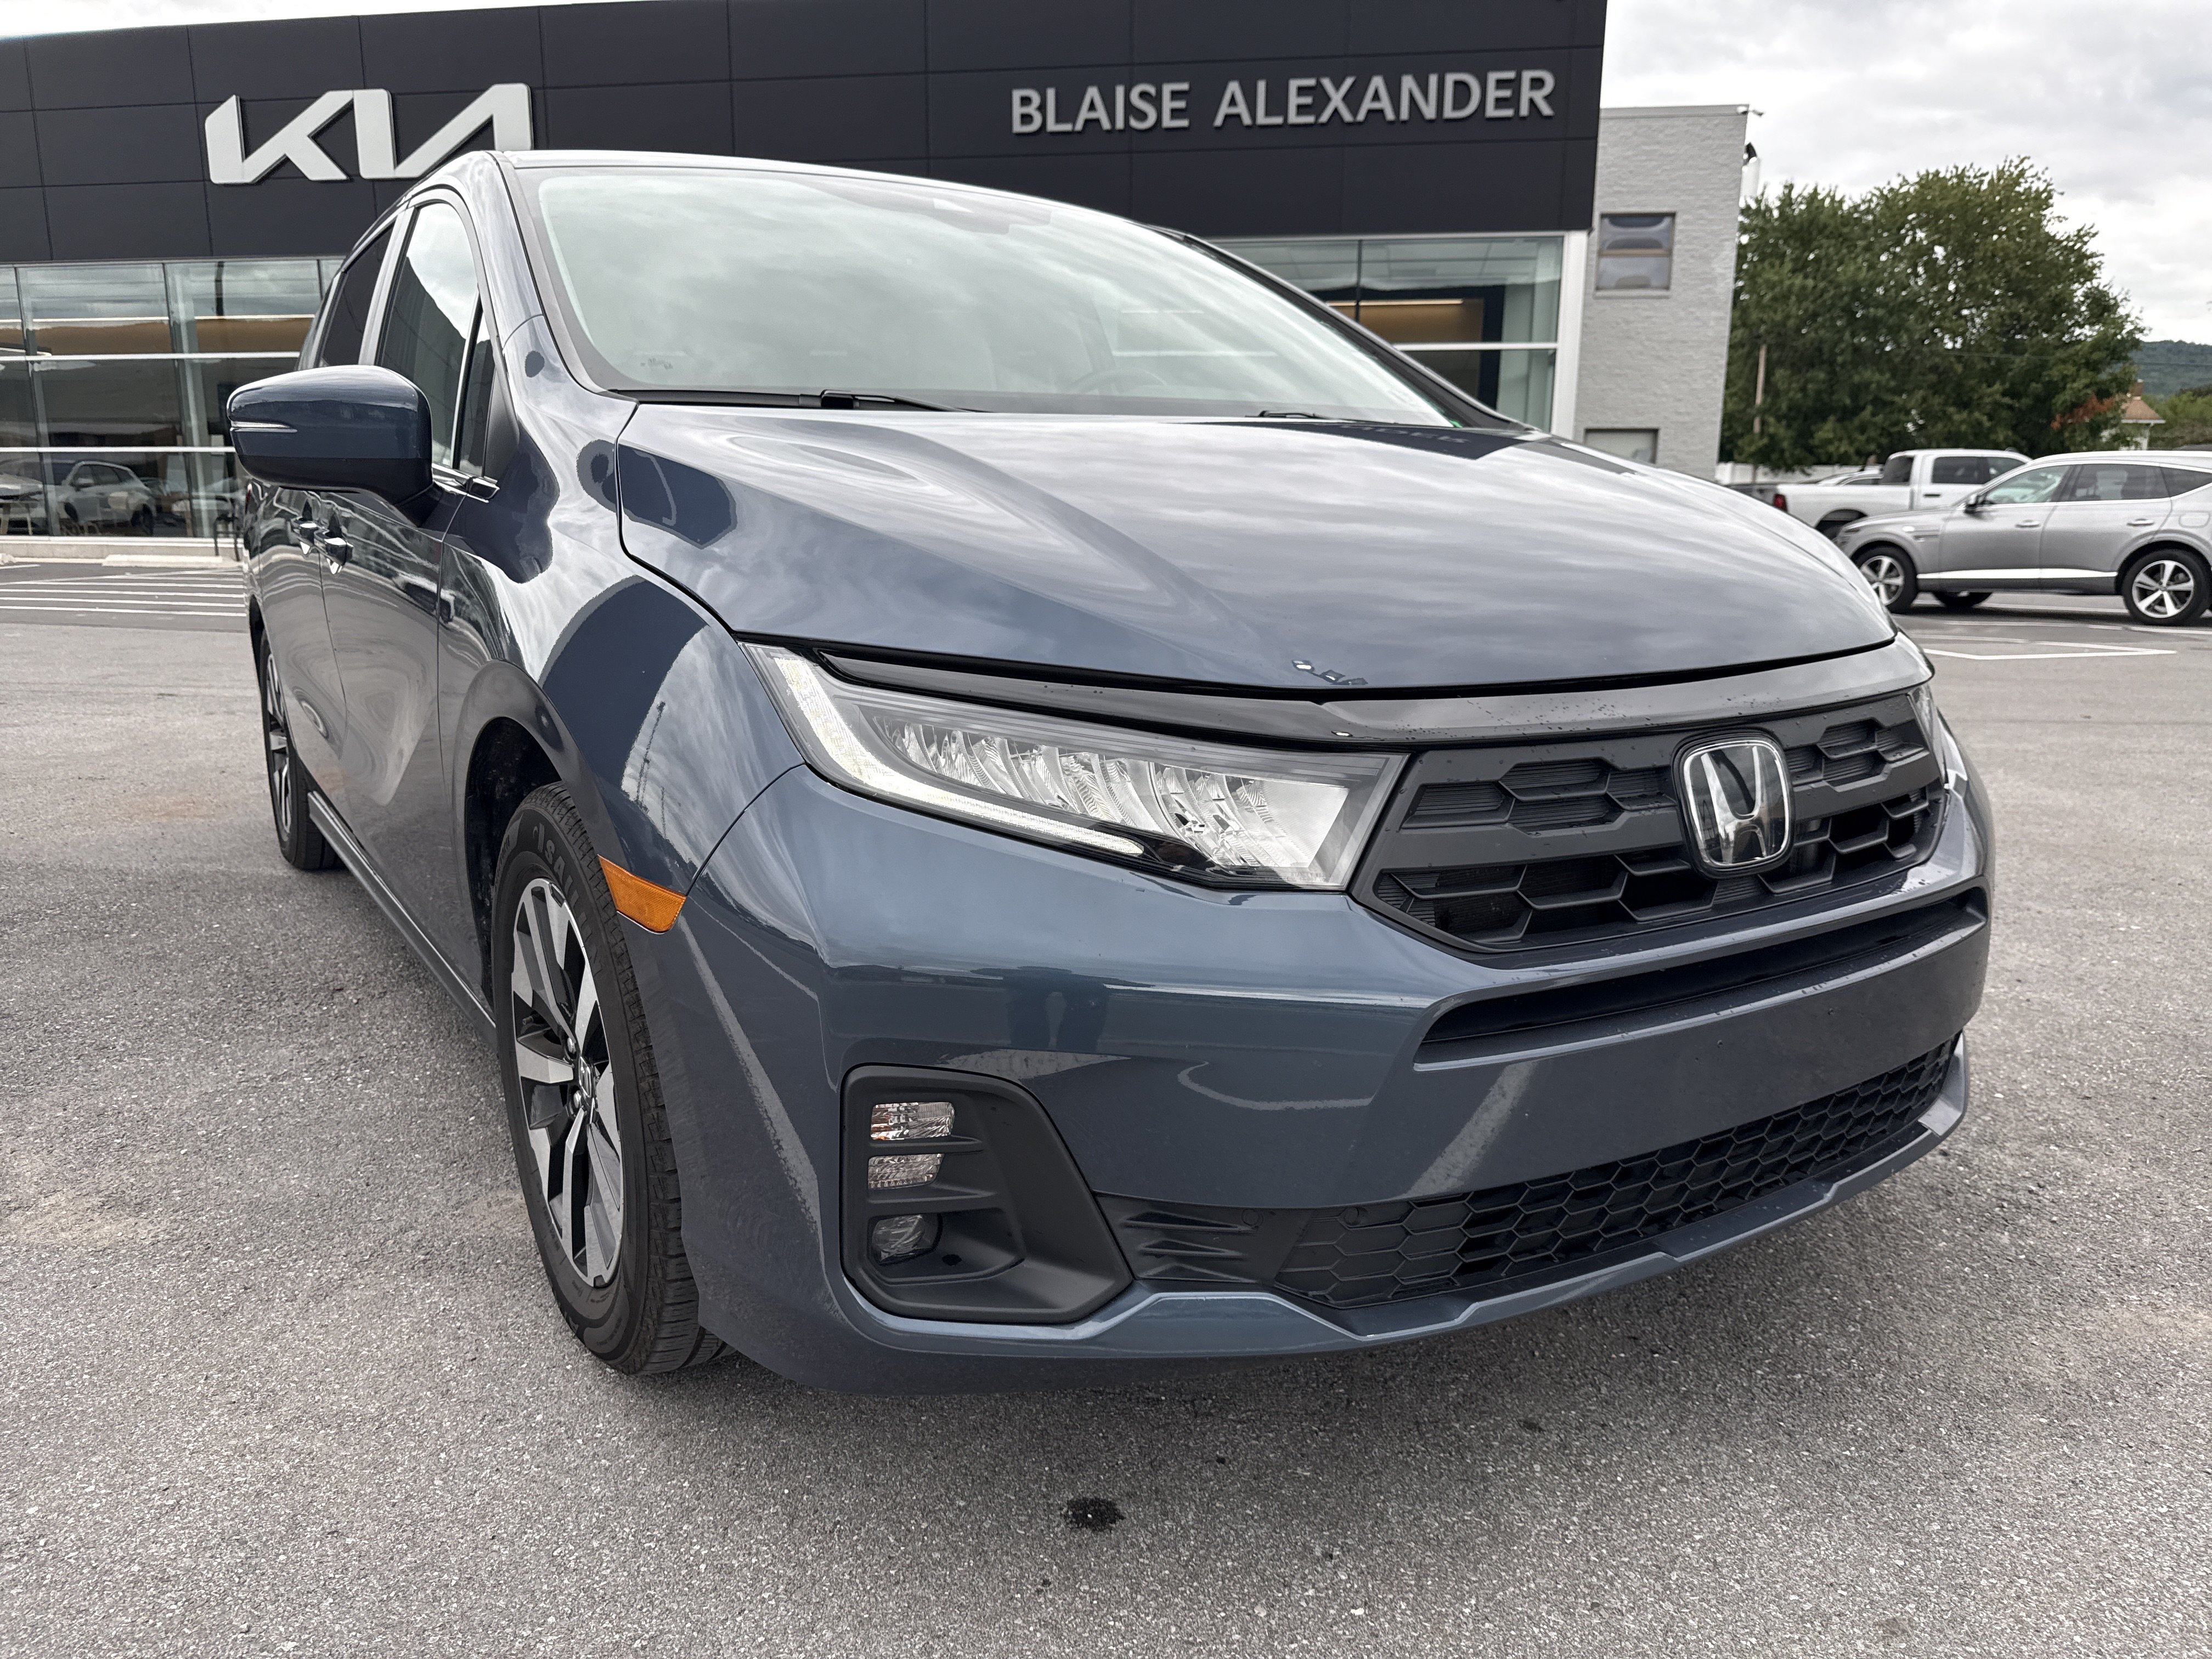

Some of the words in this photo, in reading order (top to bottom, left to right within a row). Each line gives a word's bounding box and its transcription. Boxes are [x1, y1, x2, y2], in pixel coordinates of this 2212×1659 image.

[205, 83, 533, 184] KIA
[1012, 82, 1190, 133] BLAISE
[1213, 69, 1555, 127] ALEXANDER
